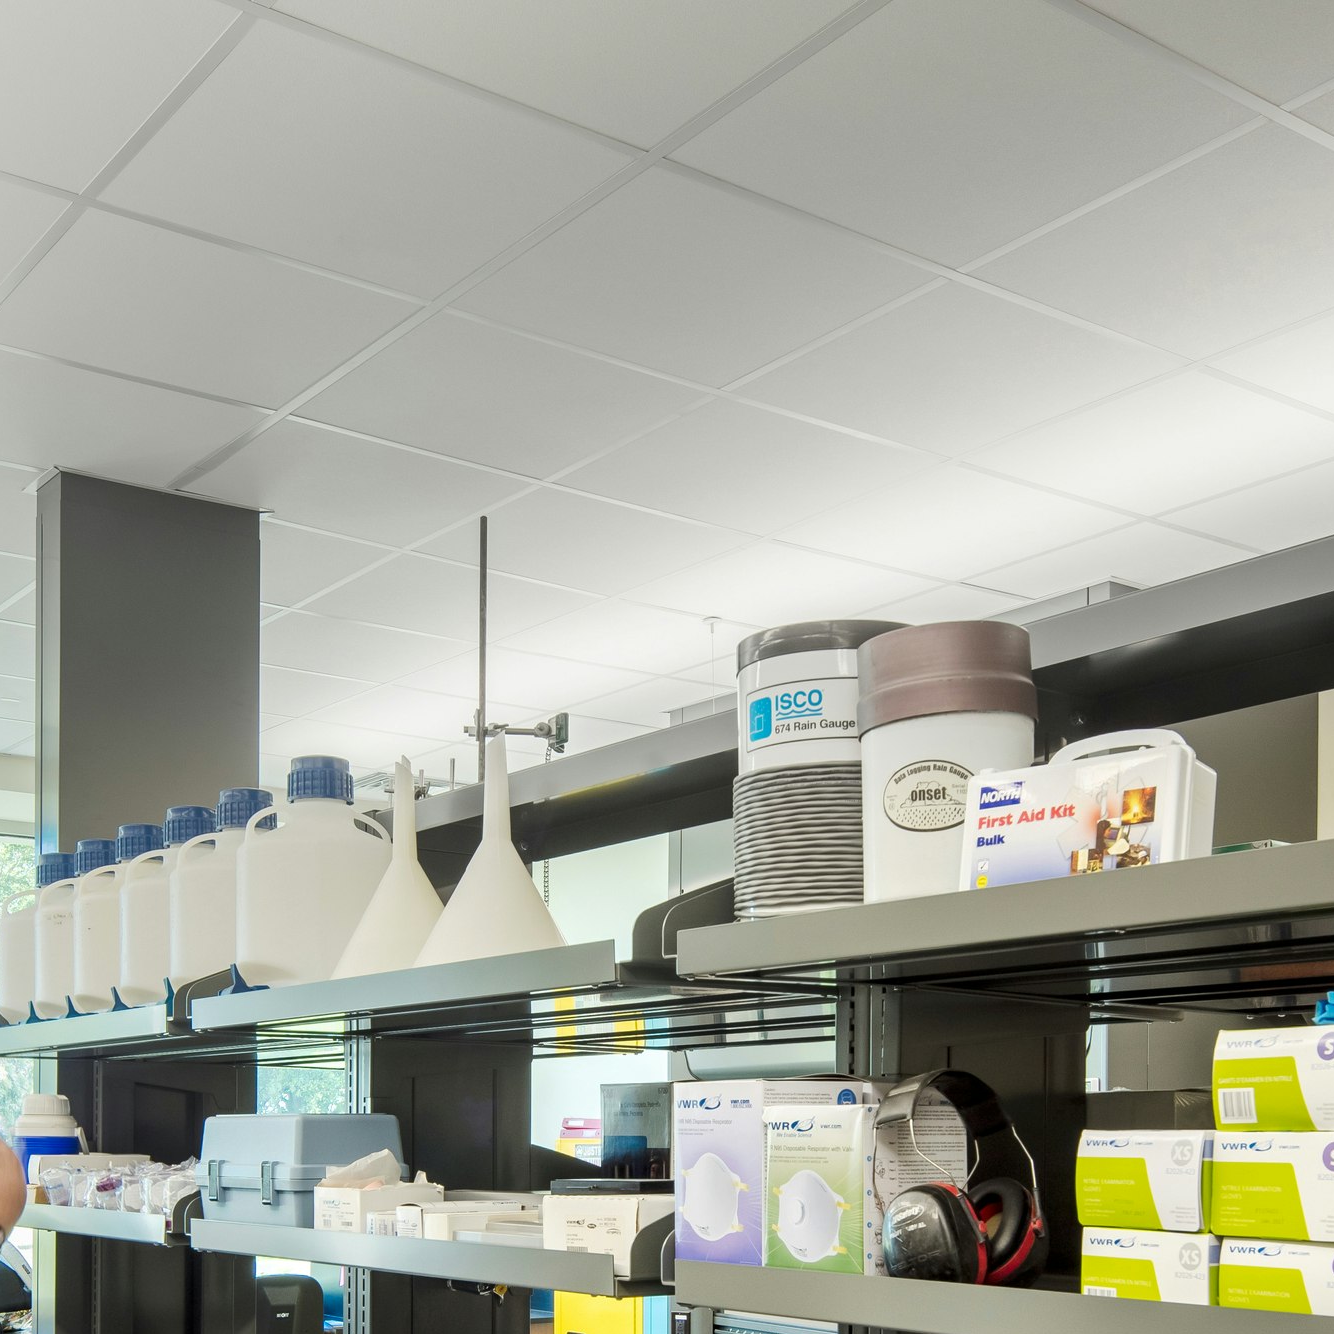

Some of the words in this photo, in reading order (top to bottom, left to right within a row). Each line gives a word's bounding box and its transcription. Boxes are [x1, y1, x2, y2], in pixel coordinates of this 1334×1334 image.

[775, 689, 823, 711] ISCO
[775, 723, 791, 734] 674
[793, 720, 817, 731] Rain
[819, 719, 856, 730] Gauge
[893, 772, 907, 785] Data
[906, 764, 932, 778] Logging
[932, 763, 948, 772] Rain
[949, 765, 969, 781] Gauge
[910, 786, 947, 803] onset
[980, 787, 1020, 804] NORTH
[977, 812, 1013, 830] First
[1017, 808, 1044, 825] Aid
[1050, 804, 1076, 818] Kit
[976, 834, 1005, 848] Bulk
[1227, 1040, 1253, 1049] VWR
[1324, 1038, 1334, 1055] S
[677, 1100, 699, 1109] VWR
[1172, 1146, 1191, 1160] XS
[1089, 1237, 1113, 1246] VWR
[1180, 1248, 1199, 1262] XS
[1229, 1245, 1256, 1255] VWR
